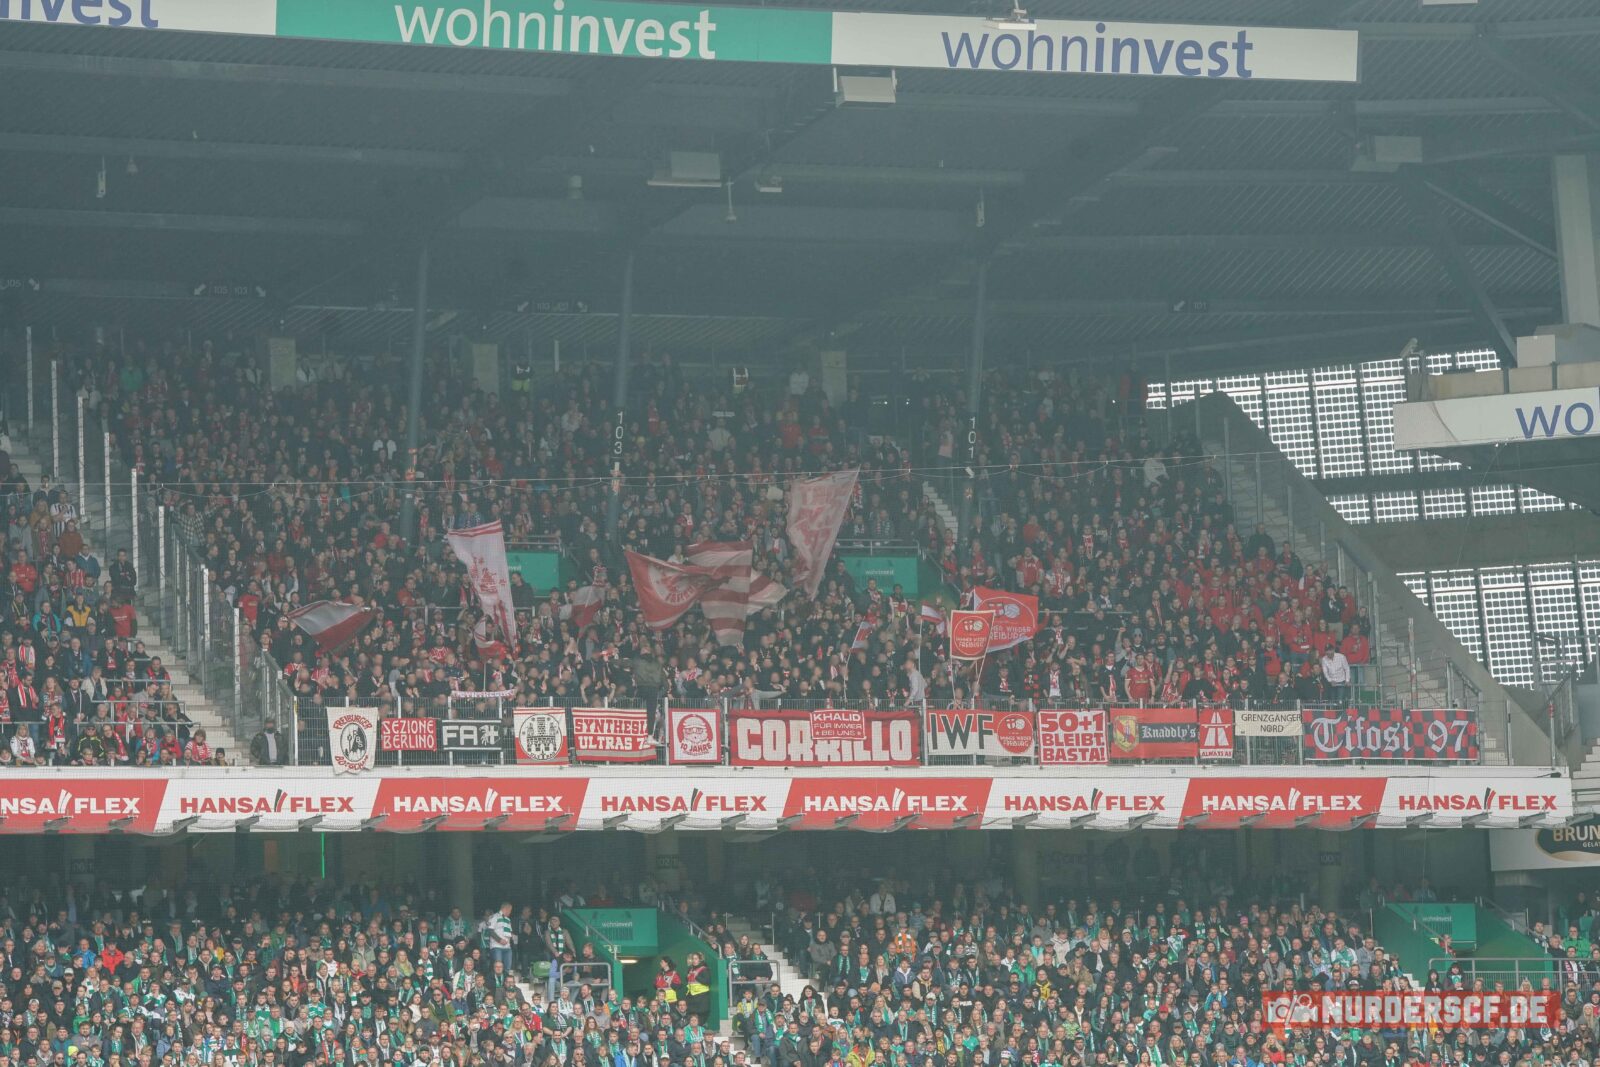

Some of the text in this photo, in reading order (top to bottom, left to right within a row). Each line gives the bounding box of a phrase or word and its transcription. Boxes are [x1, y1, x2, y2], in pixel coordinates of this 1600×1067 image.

[394, 0, 717, 60] wohninvest
[941, 22, 1253, 79] wohninvest
[614, 411, 624, 454] 103
[968, 416, 976, 459] 101
[813, 712, 861, 722] KHALID
[813, 721, 832, 729] FÜR
[1040, 712, 1103, 733] 50+1
[382, 720, 434, 735] SEZIONE
[929, 713, 994, 750] IWF
[1141, 724, 1196, 740] Knaddly's
[1310, 716, 1469, 753] Tifosi 97
[382, 734, 435, 750] BERLINO
[578, 735, 632, 750] ULTRAS
[689, 742, 712, 753] JAHRE
[1042, 747, 1105, 762] BASTA!
[74, 797, 140, 814] FLEX
[180, 796, 353, 814] HANSA FLEX
[394, 796, 563, 813] HANSA FLEX
[601, 795, 766, 812] HANSA FLEX
[804, 795, 968, 812] HANSA FLEX
[1004, 795, 1165, 811] HANSA FLEX
[1202, 795, 1362, 811] HANSA FLEX
[1399, 794, 1557, 810] HANSA FLEX
